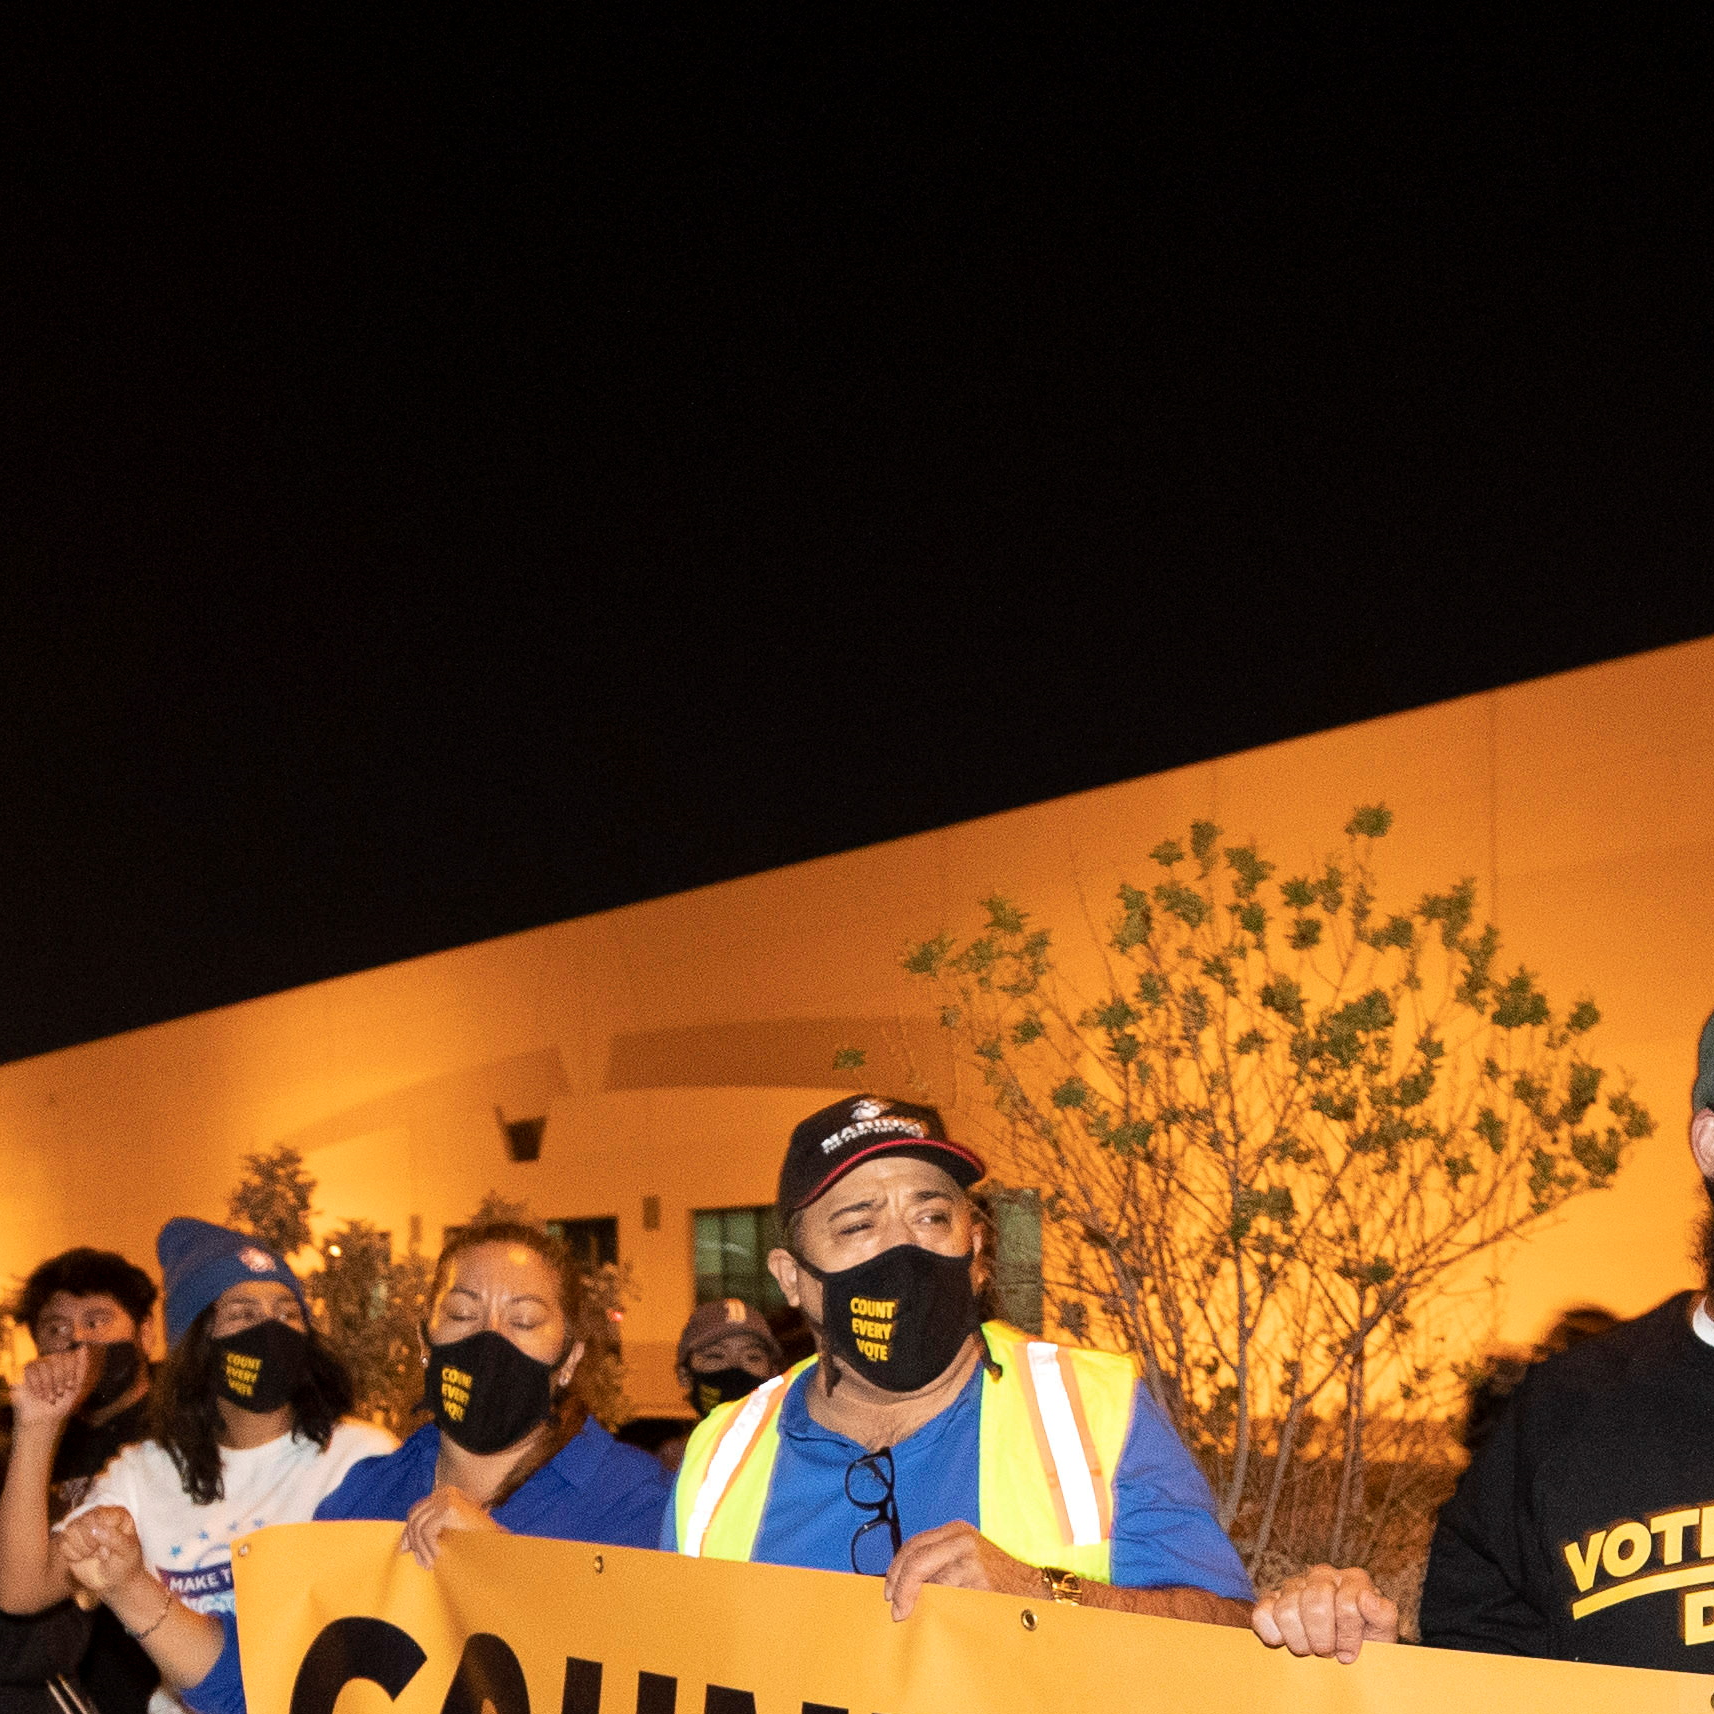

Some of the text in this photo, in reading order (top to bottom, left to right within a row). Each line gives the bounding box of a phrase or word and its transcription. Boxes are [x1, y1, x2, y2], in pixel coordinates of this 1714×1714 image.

[850, 1297, 896, 1319] COUNT
[851, 1317, 893, 1340] EVERY
[856, 1337, 888, 1361] VOTE
[226, 1352, 262, 1371] COUNT
[168, 1571, 221, 1593] MAKE
